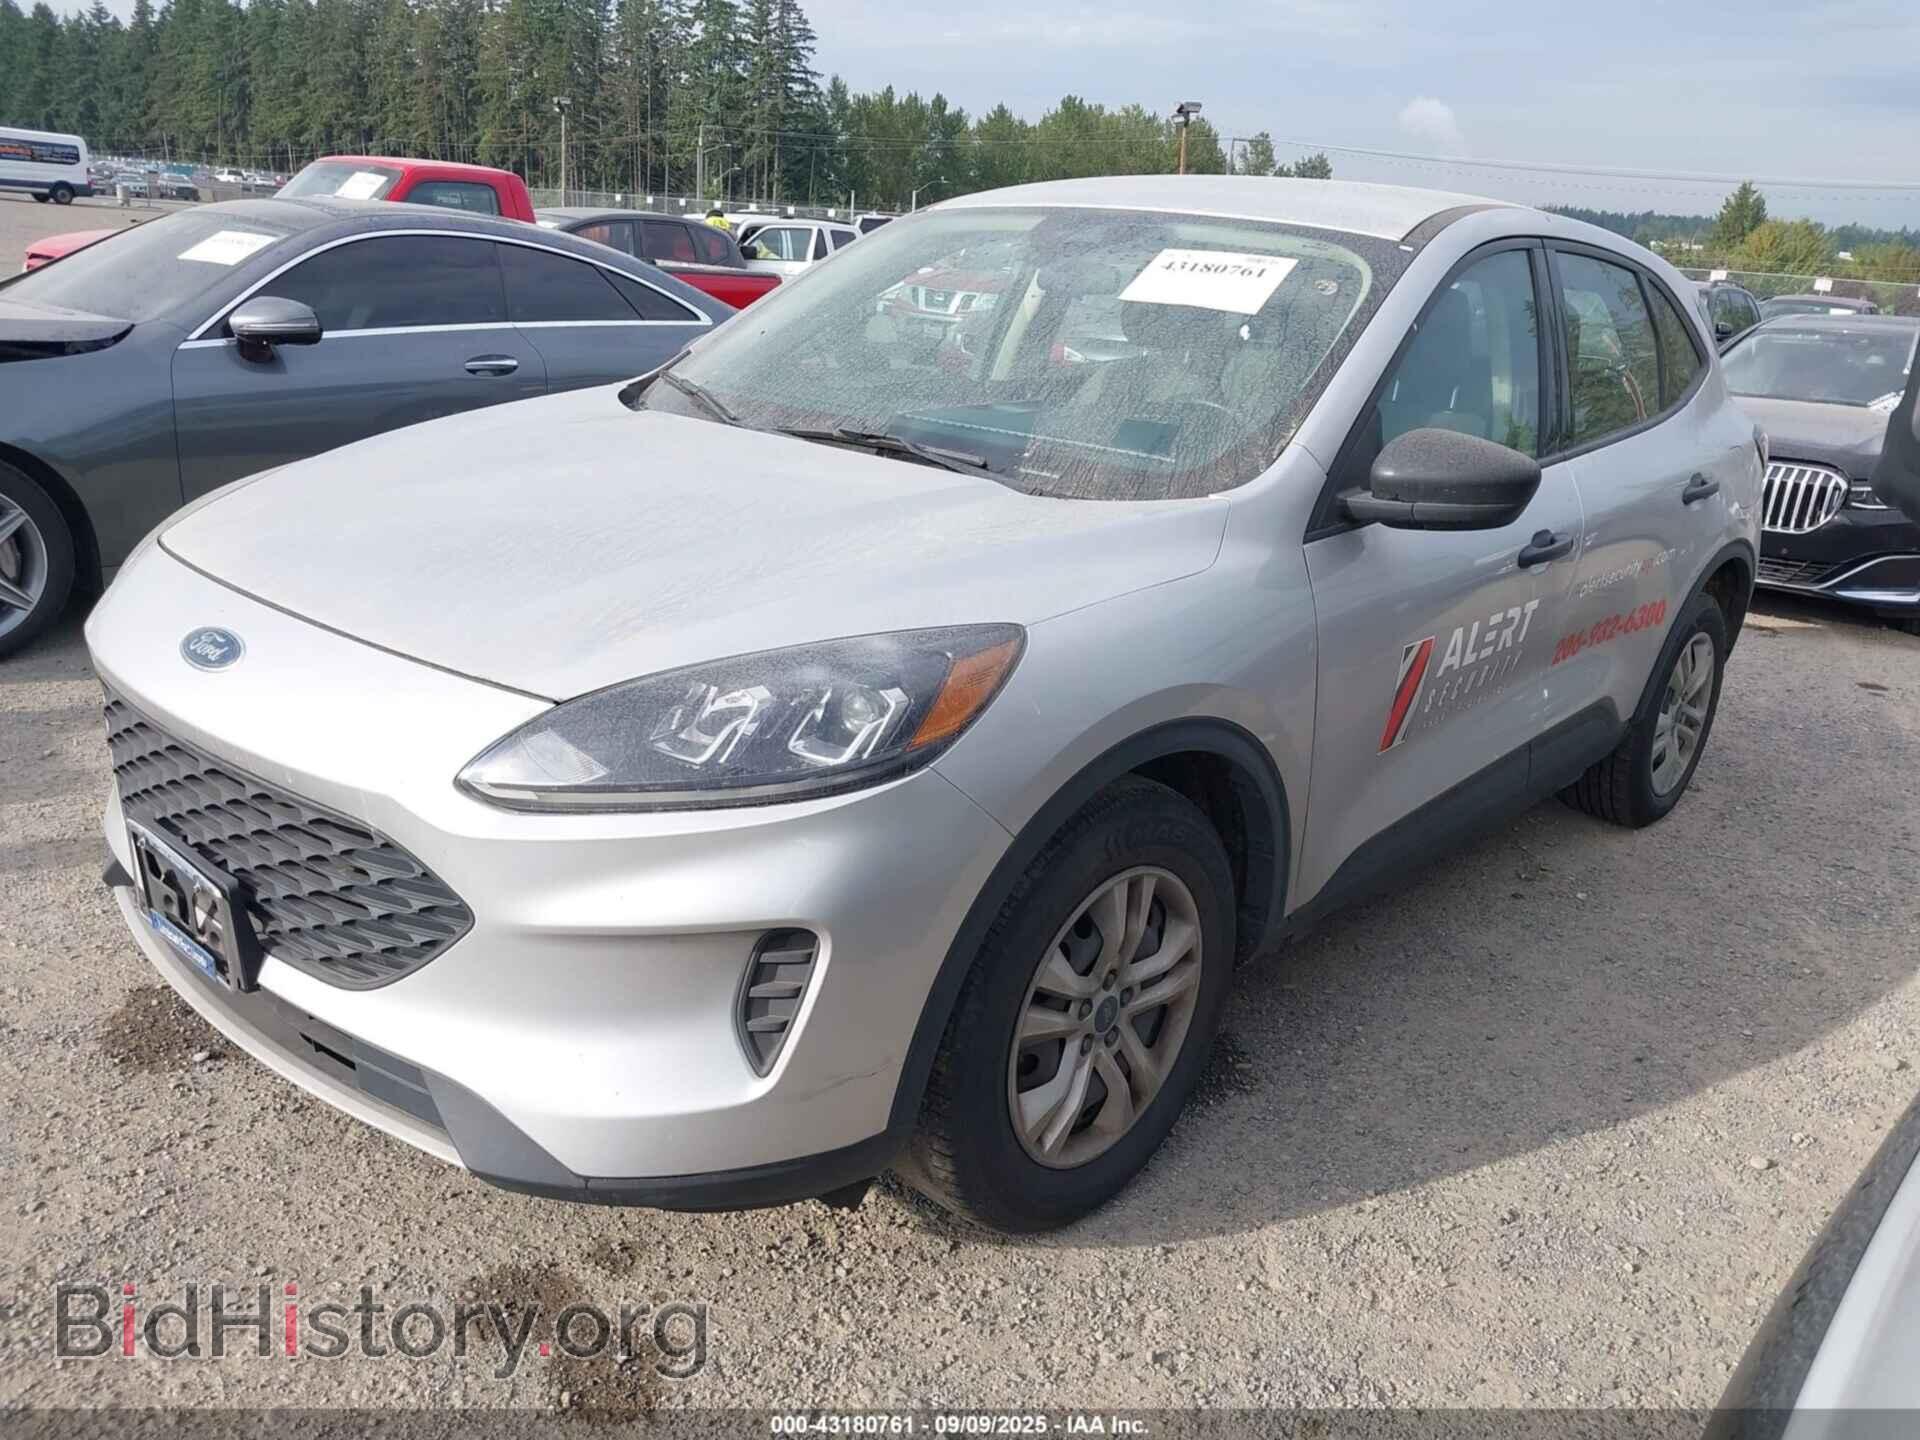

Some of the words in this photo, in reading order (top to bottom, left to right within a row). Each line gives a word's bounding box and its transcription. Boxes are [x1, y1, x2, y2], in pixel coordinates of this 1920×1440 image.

[1161, 261, 1267, 279] 43180761
[190, 631, 229, 661] Ford
[1436, 599, 1540, 678] ALERT
